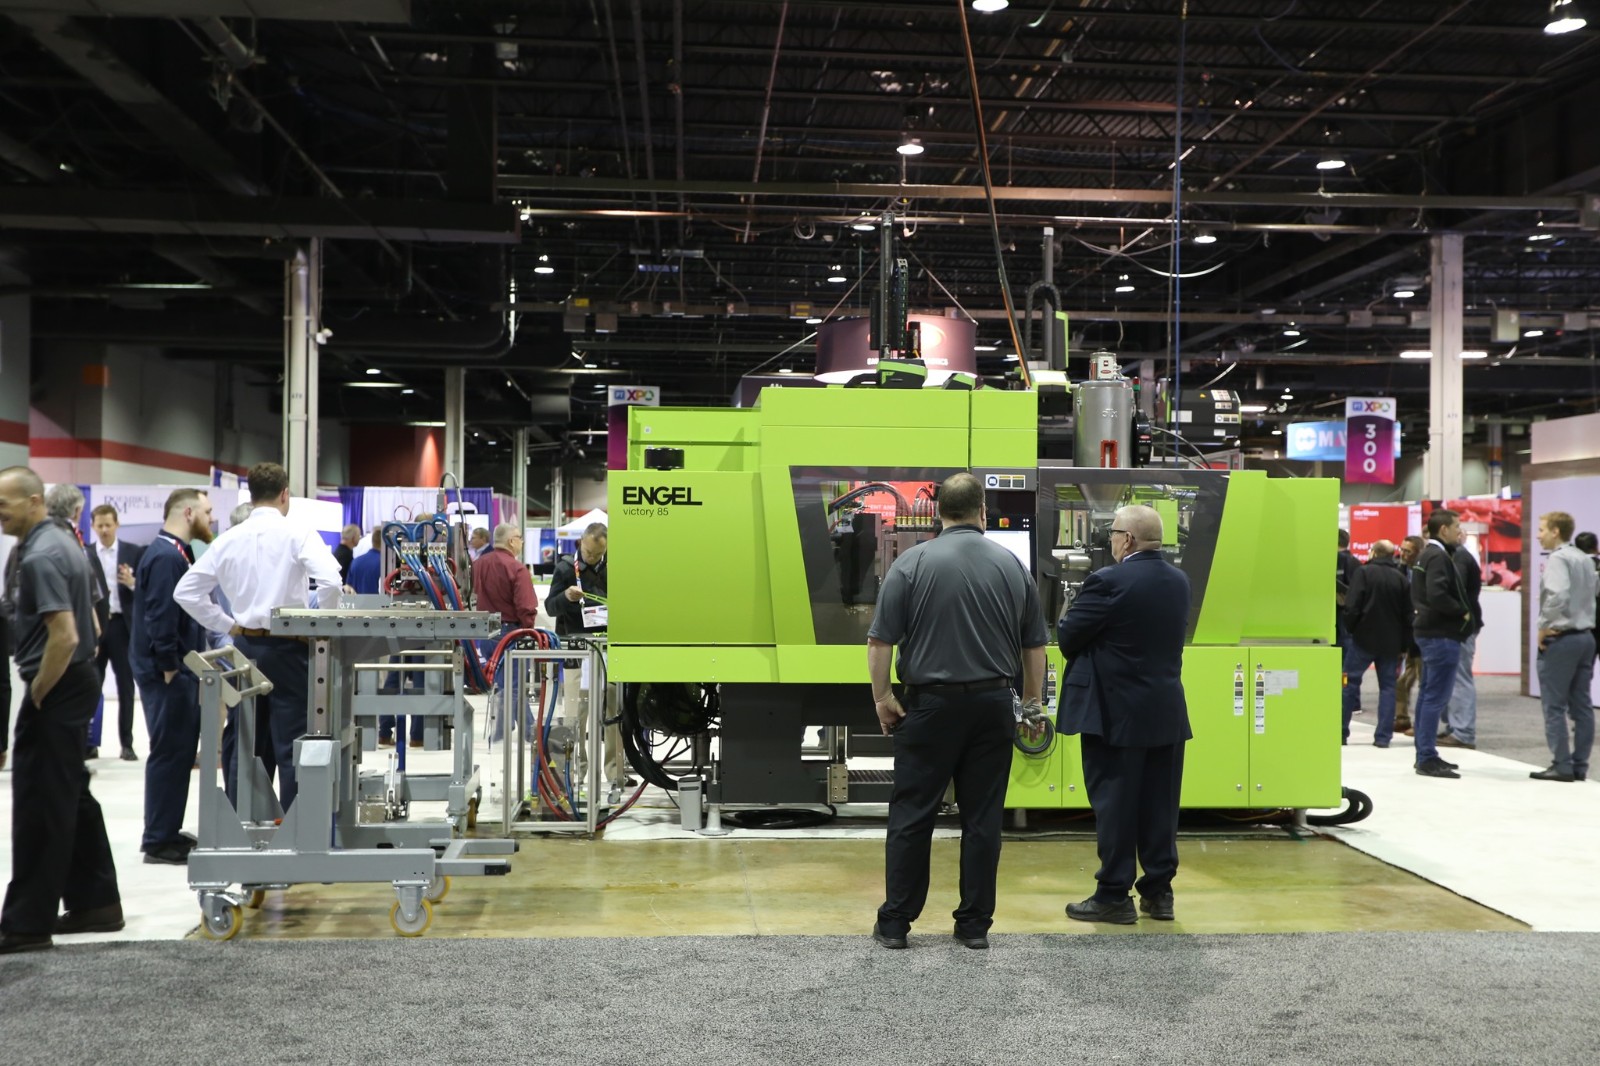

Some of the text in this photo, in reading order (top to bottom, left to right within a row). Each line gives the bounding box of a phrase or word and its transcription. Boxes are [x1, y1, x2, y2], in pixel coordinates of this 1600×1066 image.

[627, 389, 654, 401] XPO
[1365, 400, 1390, 412] XPO
[623, 486, 702, 506] ENGEL
[624, 508, 669, 517] victory 85
